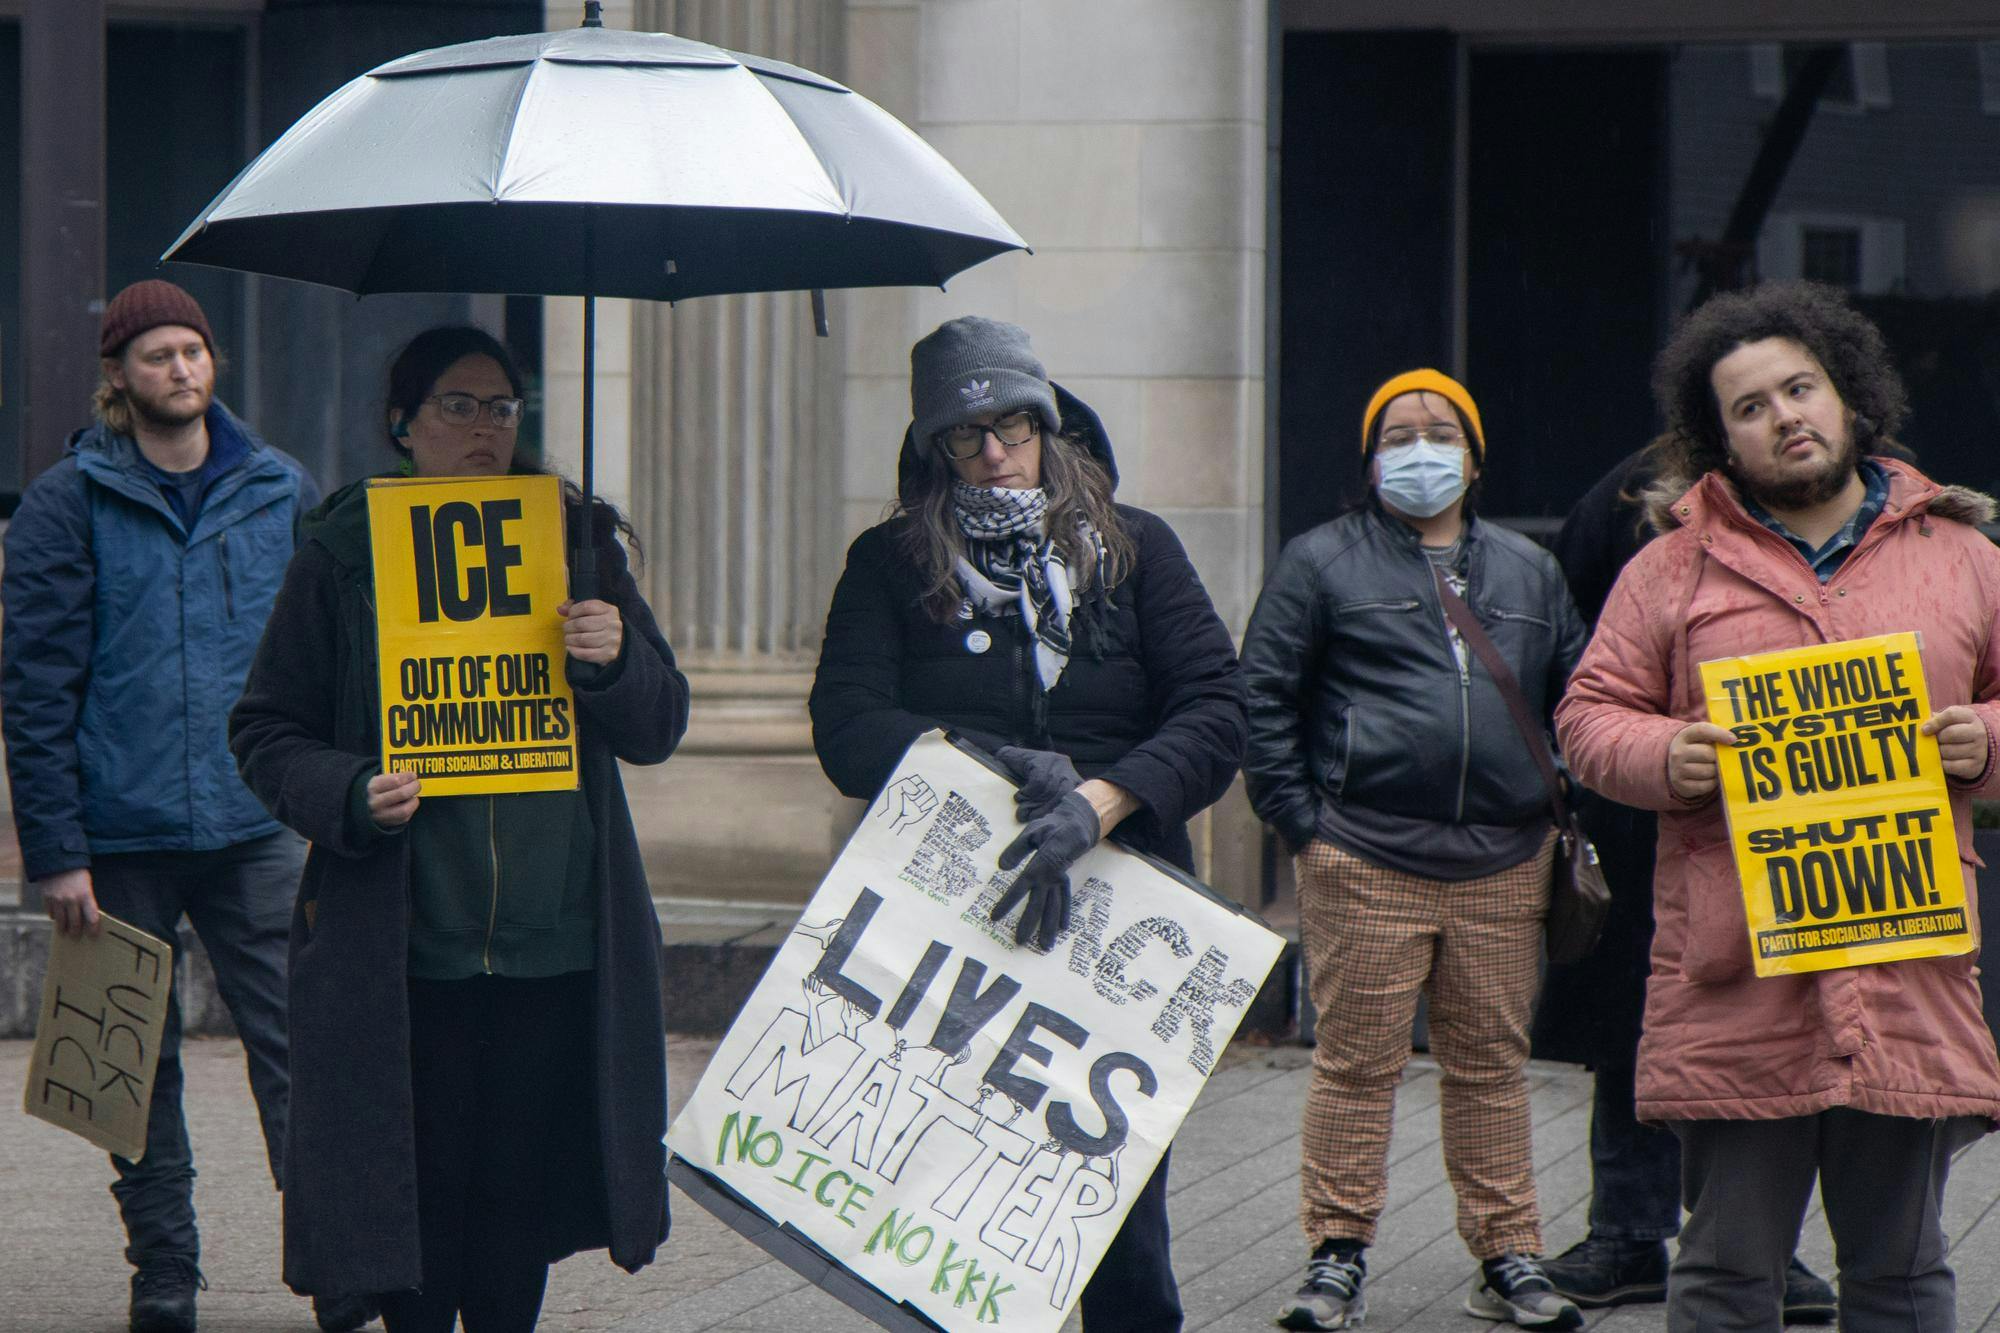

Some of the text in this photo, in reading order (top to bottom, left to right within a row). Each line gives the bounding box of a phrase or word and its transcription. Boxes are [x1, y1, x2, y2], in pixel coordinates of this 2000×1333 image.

[410, 499, 531, 623] ICE
[401, 653, 550, 701] OUT OF OUR
[1721, 652, 1911, 723] THE WHOLE
[388, 697, 570, 748] COMMUNITIES
[1729, 697, 1921, 748] SYSTEM
[393, 751, 569, 775] PARTY FOR SOCIALISM & LIBERATION
[1738, 723, 1921, 803] IS GUILTY
[1749, 808, 1940, 854] SHUT IT
[1766, 838, 1942, 924] DOWN!
[1762, 913, 1962, 952] PARTY FOR SOCIALISM & LIBERATION
[44, 985, 106, 1120] ICE
[100, 931, 159, 1107] FUCK
[815, 887, 1157, 1157] LIVES
[725, 1008, 1117, 1310] MATTER
[716, 1111, 1016, 1324] NO ICE NO KKK
